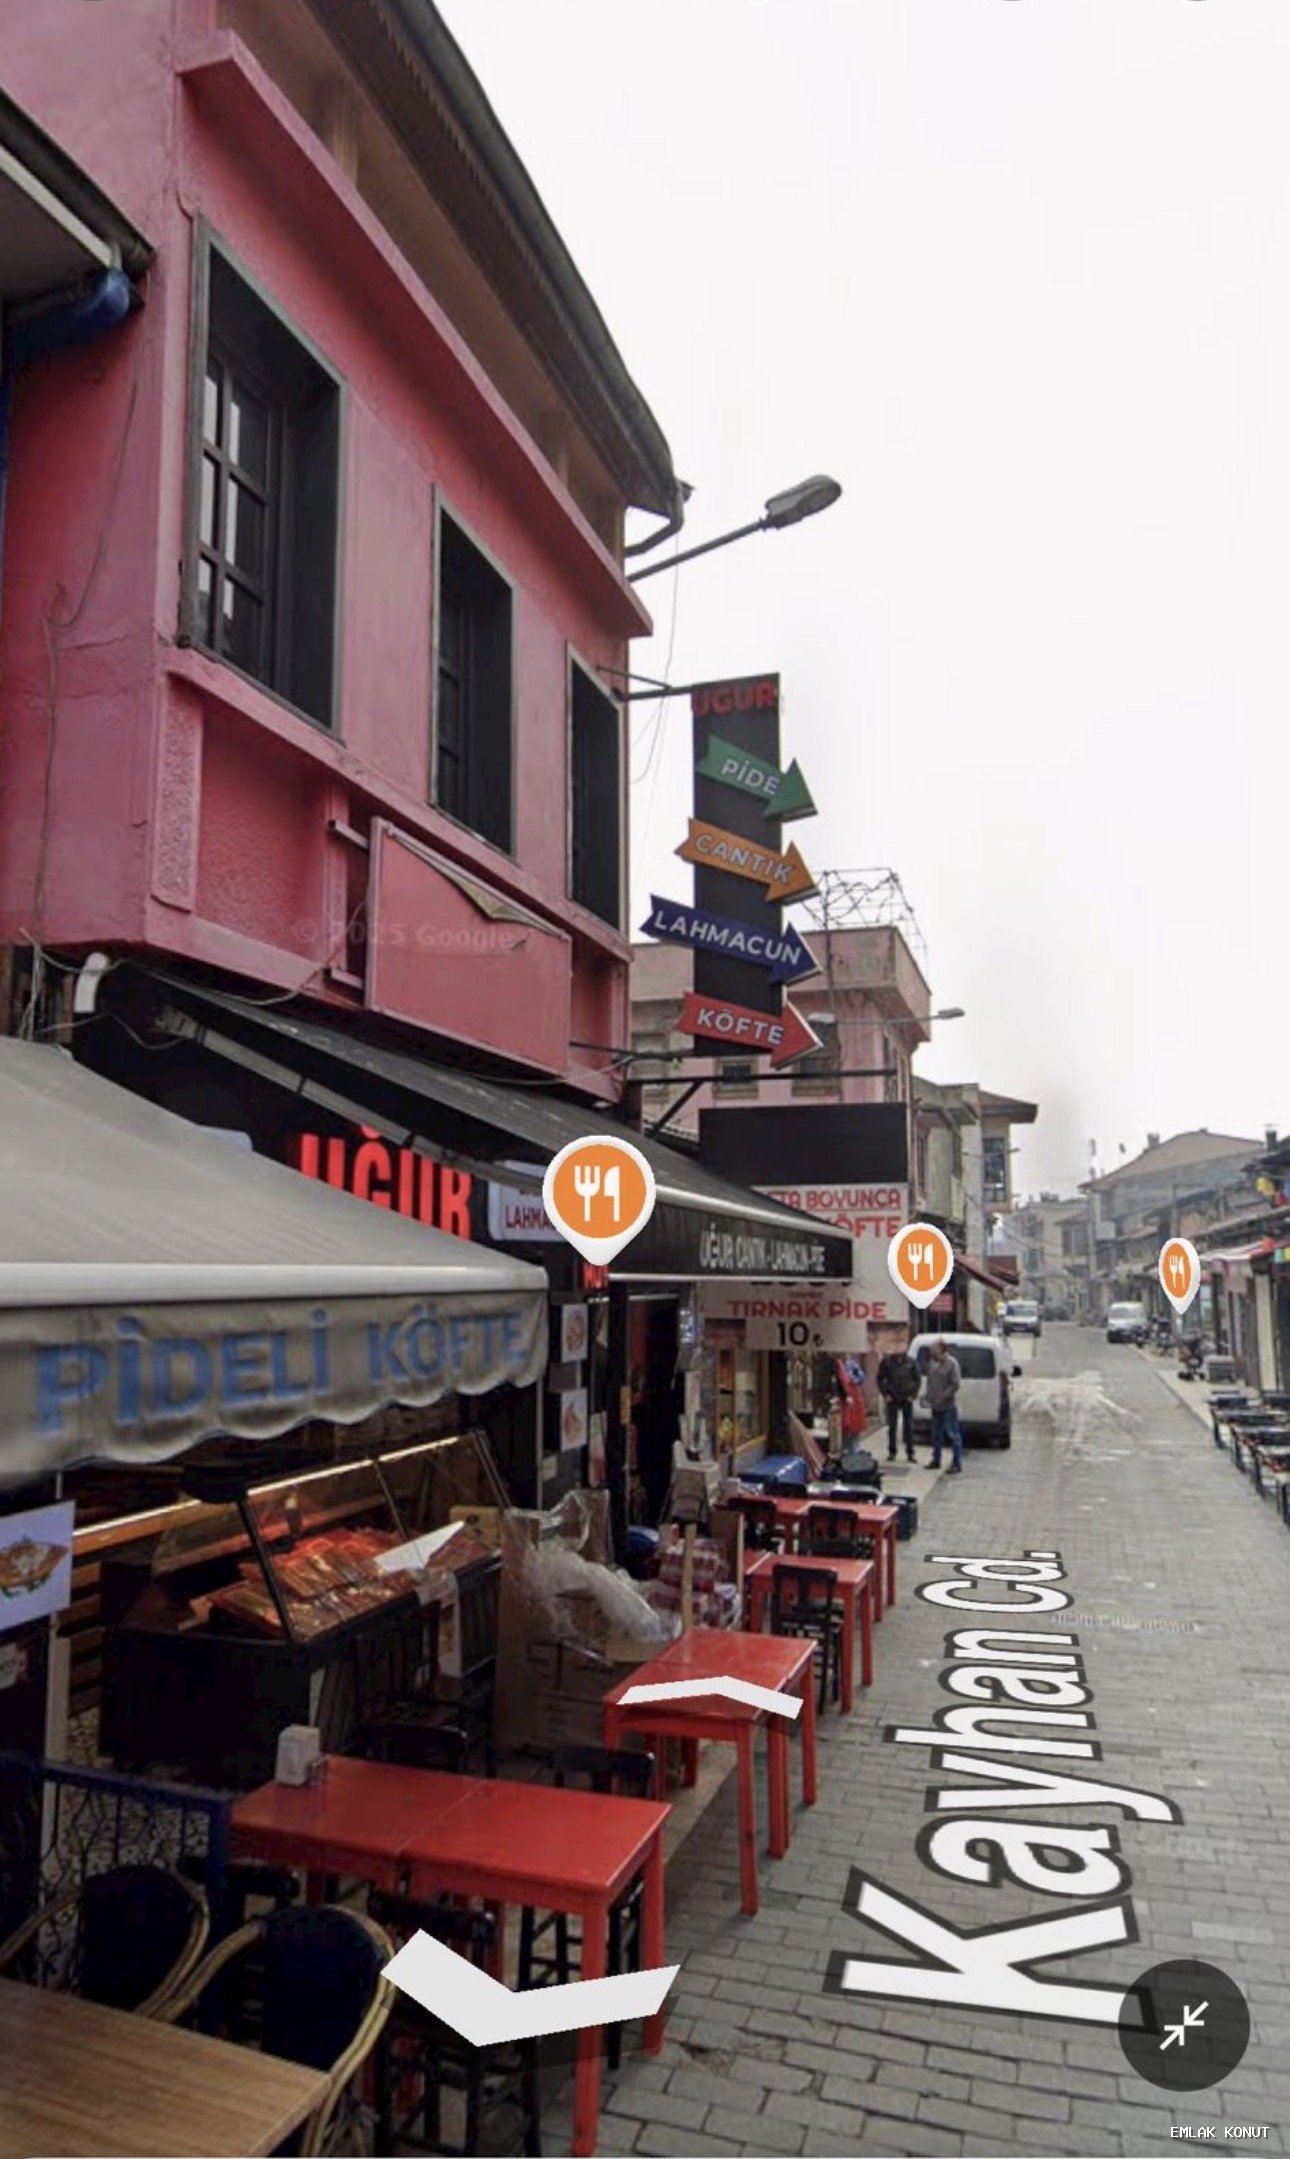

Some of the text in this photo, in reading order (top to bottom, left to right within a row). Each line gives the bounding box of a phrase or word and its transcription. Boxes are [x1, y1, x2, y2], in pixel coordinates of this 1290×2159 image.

[721, 758, 780, 795] PİDE
[696, 834, 794, 884] CANTIK
[654, 909, 801, 966] LAHMACUN
[697, 1007, 785, 1045] KÖFTE
[806, 1188, 900, 1209] BOYUNCA
[505, 1204, 556, 1231] LAHMA
[832, 1213, 901, 1238] ÖFTE
[728, 1297, 887, 1320] TIRNAK PİDE
[34, 1301, 530, 1438] PİDELİ KÖFTE
